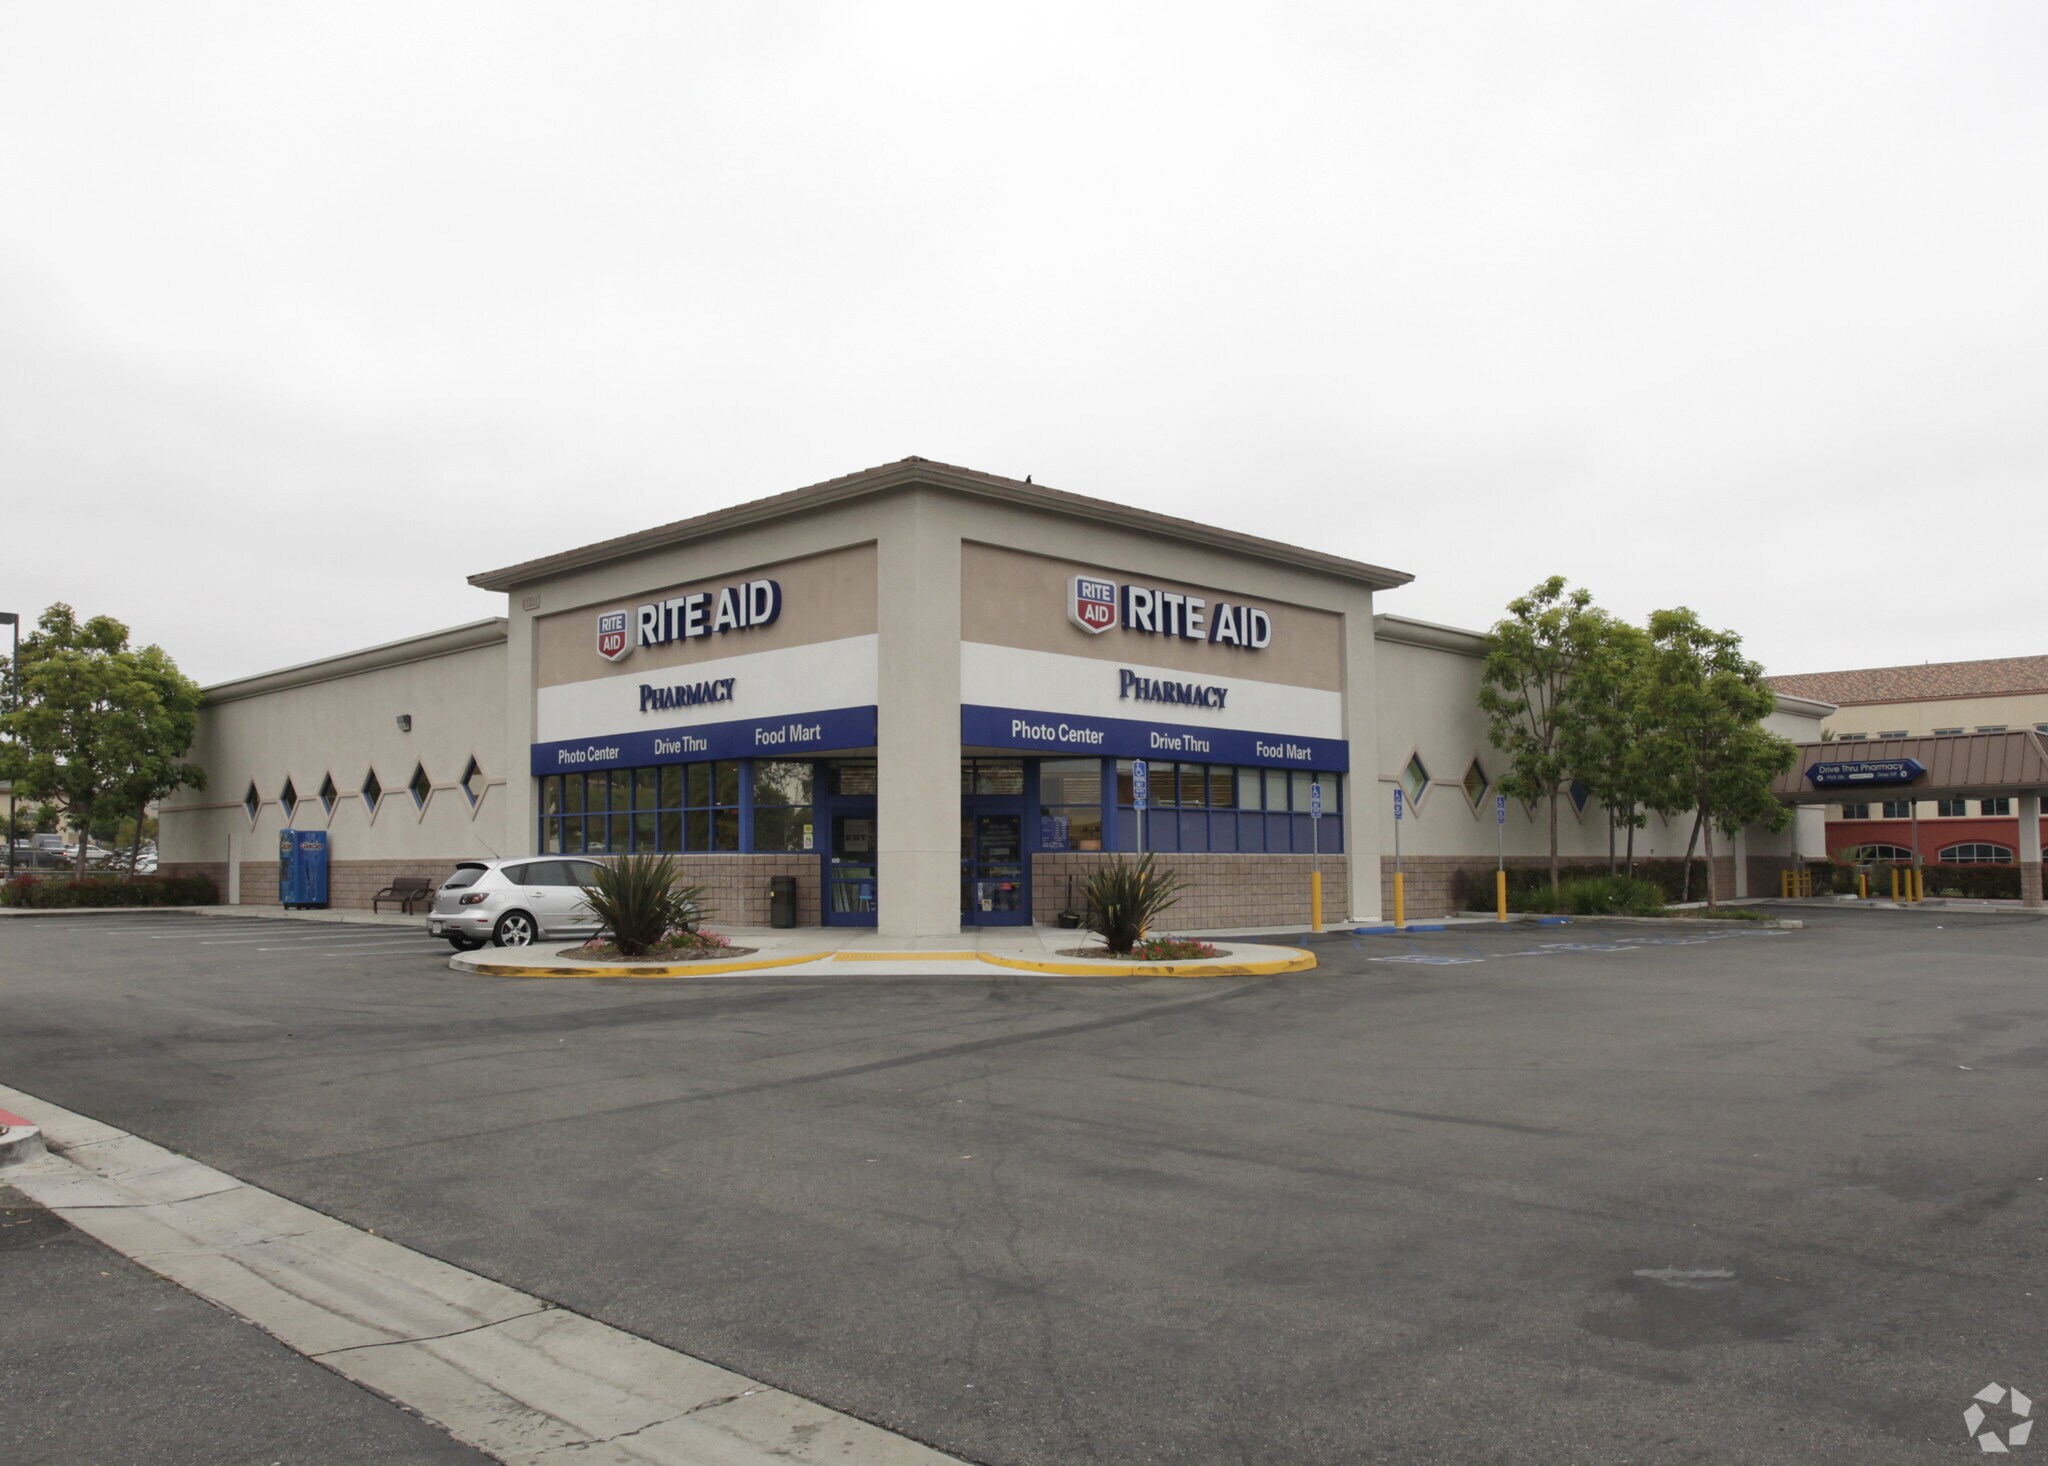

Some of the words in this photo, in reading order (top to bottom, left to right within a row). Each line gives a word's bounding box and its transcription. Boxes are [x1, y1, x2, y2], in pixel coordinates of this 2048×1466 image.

[1082, 581, 1111, 600] RITE
[602, 614, 623, 631] RITE
[637, 593, 710, 646] RITE
[713, 579, 780, 632] AID
[1084, 604, 1109, 622] AID
[1124, 585, 1206, 640] RITE
[1210, 604, 1271, 649] AID
[603, 635, 621, 652] AID
[639, 677, 735, 713] PHARMACY
[1119, 668, 1228, 709] PHARMACY
[755, 725, 786, 746] Food
[790, 723, 821, 743] Mart
[1012, 720, 1055, 741] Photo
[1058, 724, 1104, 745] Center
[1150, 732, 1181, 751] Drive
[1182, 735, 1210, 753] Thru
[558, 750, 586, 765] Photo
[588, 746, 619, 761] Center
[654, 737, 681, 756] Drive
[682, 736, 707, 753] Thru
[1256, 742, 1284, 758] Food
[1287, 744, 1312, 760] Mart
[1819, 766, 1840, 774] Drive
[1861, 763, 1904, 772] Pharmacy
